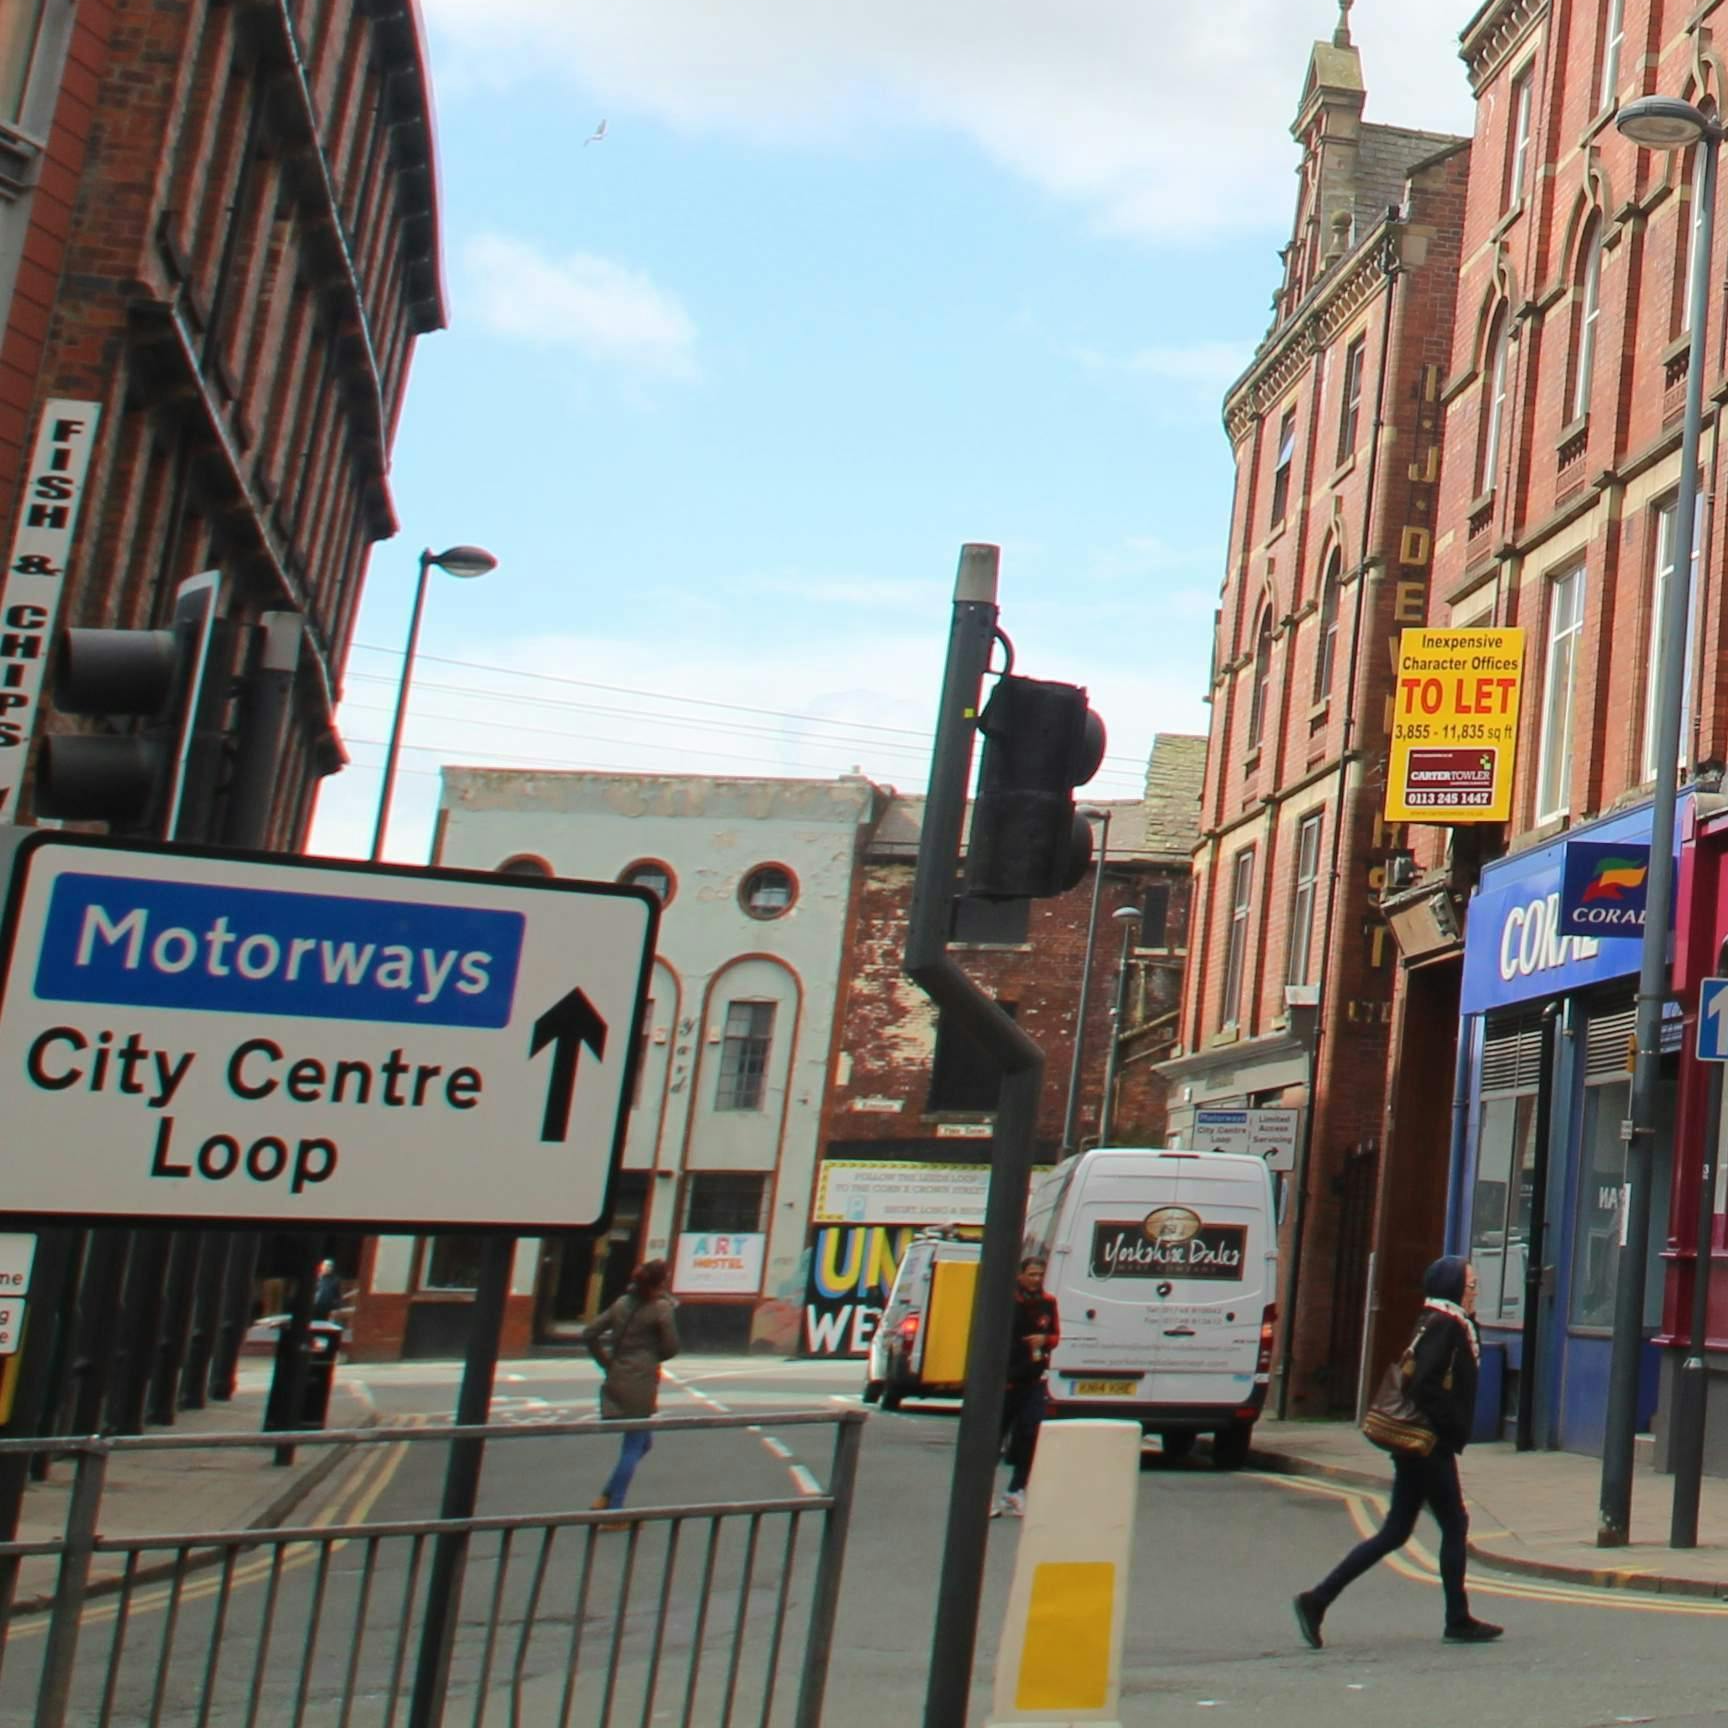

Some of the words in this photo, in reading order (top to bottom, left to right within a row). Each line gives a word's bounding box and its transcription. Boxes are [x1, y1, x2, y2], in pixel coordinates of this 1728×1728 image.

[27, 419, 84, 529] FISH
[12, 555, 63, 577] &
[1421, 633, 1503, 651] Inexpensive
[1402, 656, 1467, 671] Character
[1471, 656, 1518, 671] Offices
[1400, 677, 1444, 714] TO
[1455, 677, 1517, 714] LET
[1395, 724, 1430, 741] 3,855
[1442, 724, 1484, 742] 11,835
[1487, 727, 1501, 743] sq
[1503, 725, 1513, 740] ft
[1408, 792, 1435, 804] 0113
[1437, 792, 1458, 804] 245
[1461, 792, 1489, 804] 1447
[1572, 906, 1647, 924] CORAL
[76, 903, 494, 1004] Motorways
[26, 1026, 196, 1108] City
[226, 1037, 484, 1110] Centre
[1258, 1112, 1290, 1123] Limited
[1197, 1126, 1214, 1135] City
[1217, 1126, 1247, 1134] Centre
[1258, 1124, 1289, 1132] Access
[1210, 1135, 1231, 1144] Loop
[1253, 1135, 1293, 1144] Servicing
[150, 1116, 339, 1194] Loop
[693, 1236, 748, 1255] ART
[1189, 1238, 1241, 1267] Dales
